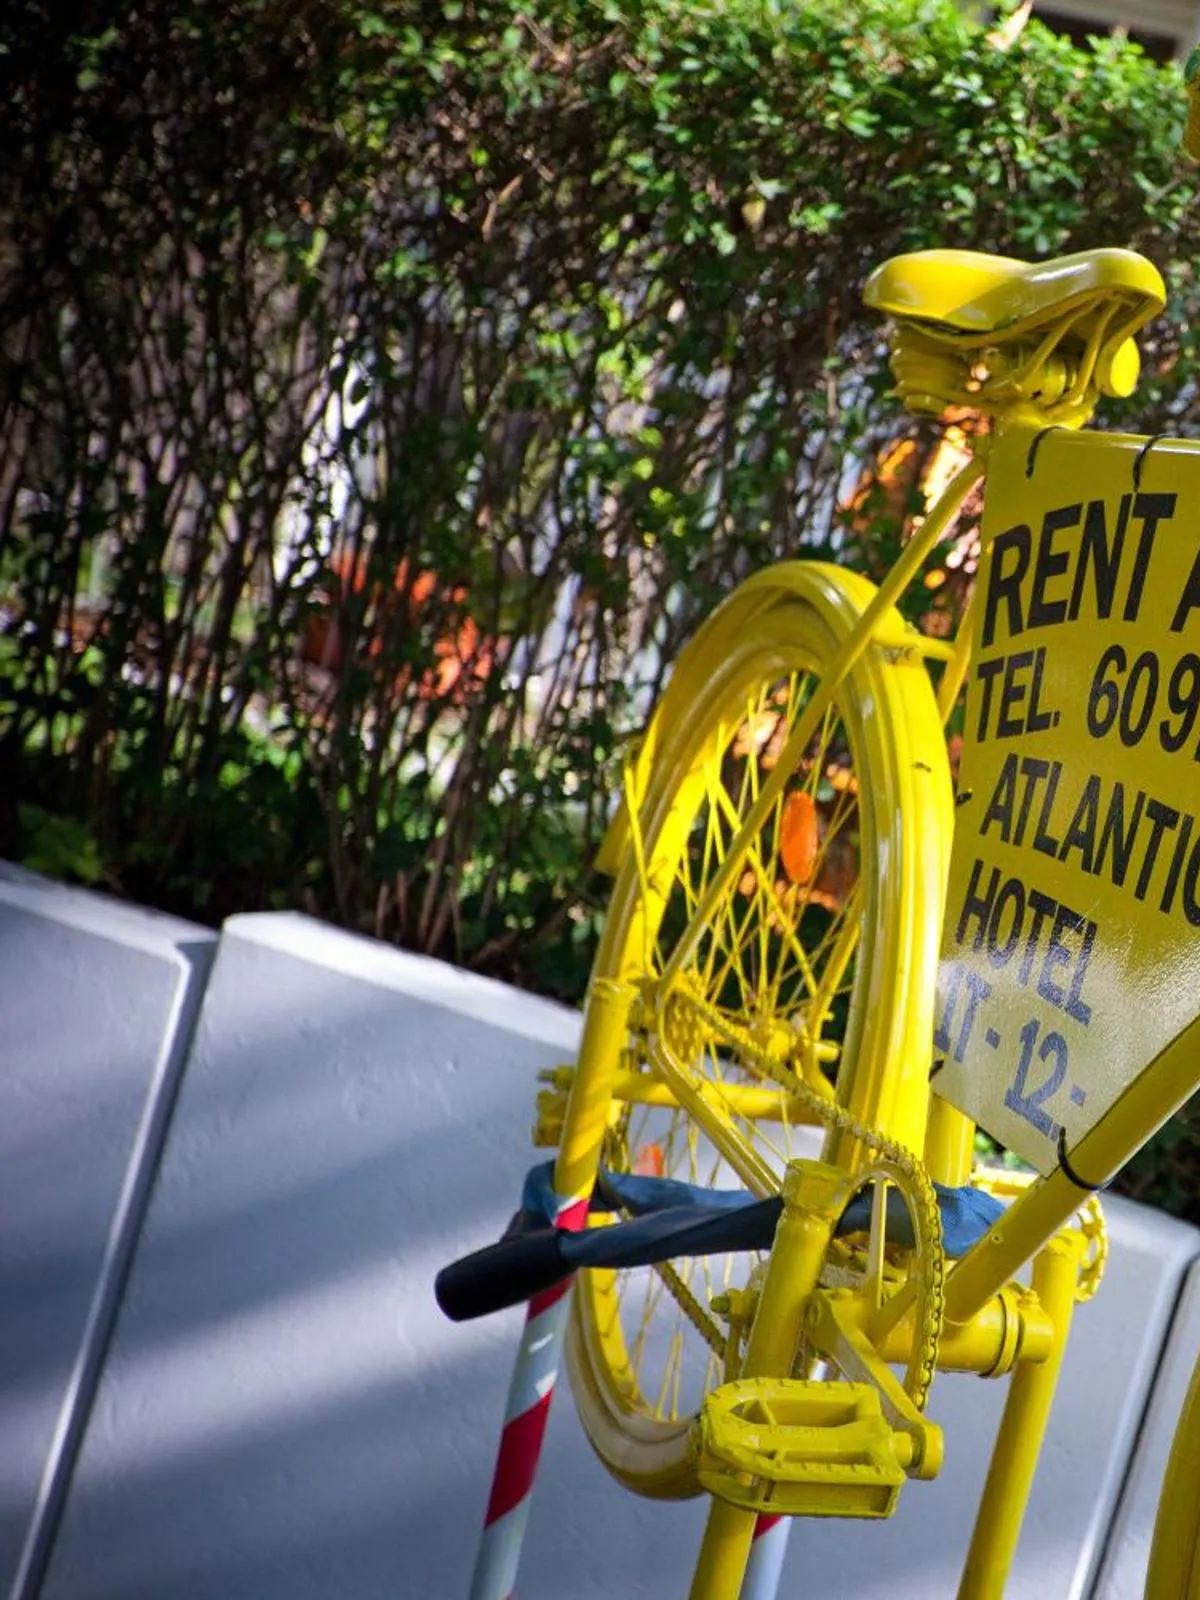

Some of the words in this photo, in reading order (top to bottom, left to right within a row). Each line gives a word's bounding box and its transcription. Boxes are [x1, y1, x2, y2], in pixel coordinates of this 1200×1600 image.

[981, 493, 1178, 648] RENT
[976, 648, 1061, 744] TEL.
[956, 859, 1097, 1025] HOTEL
